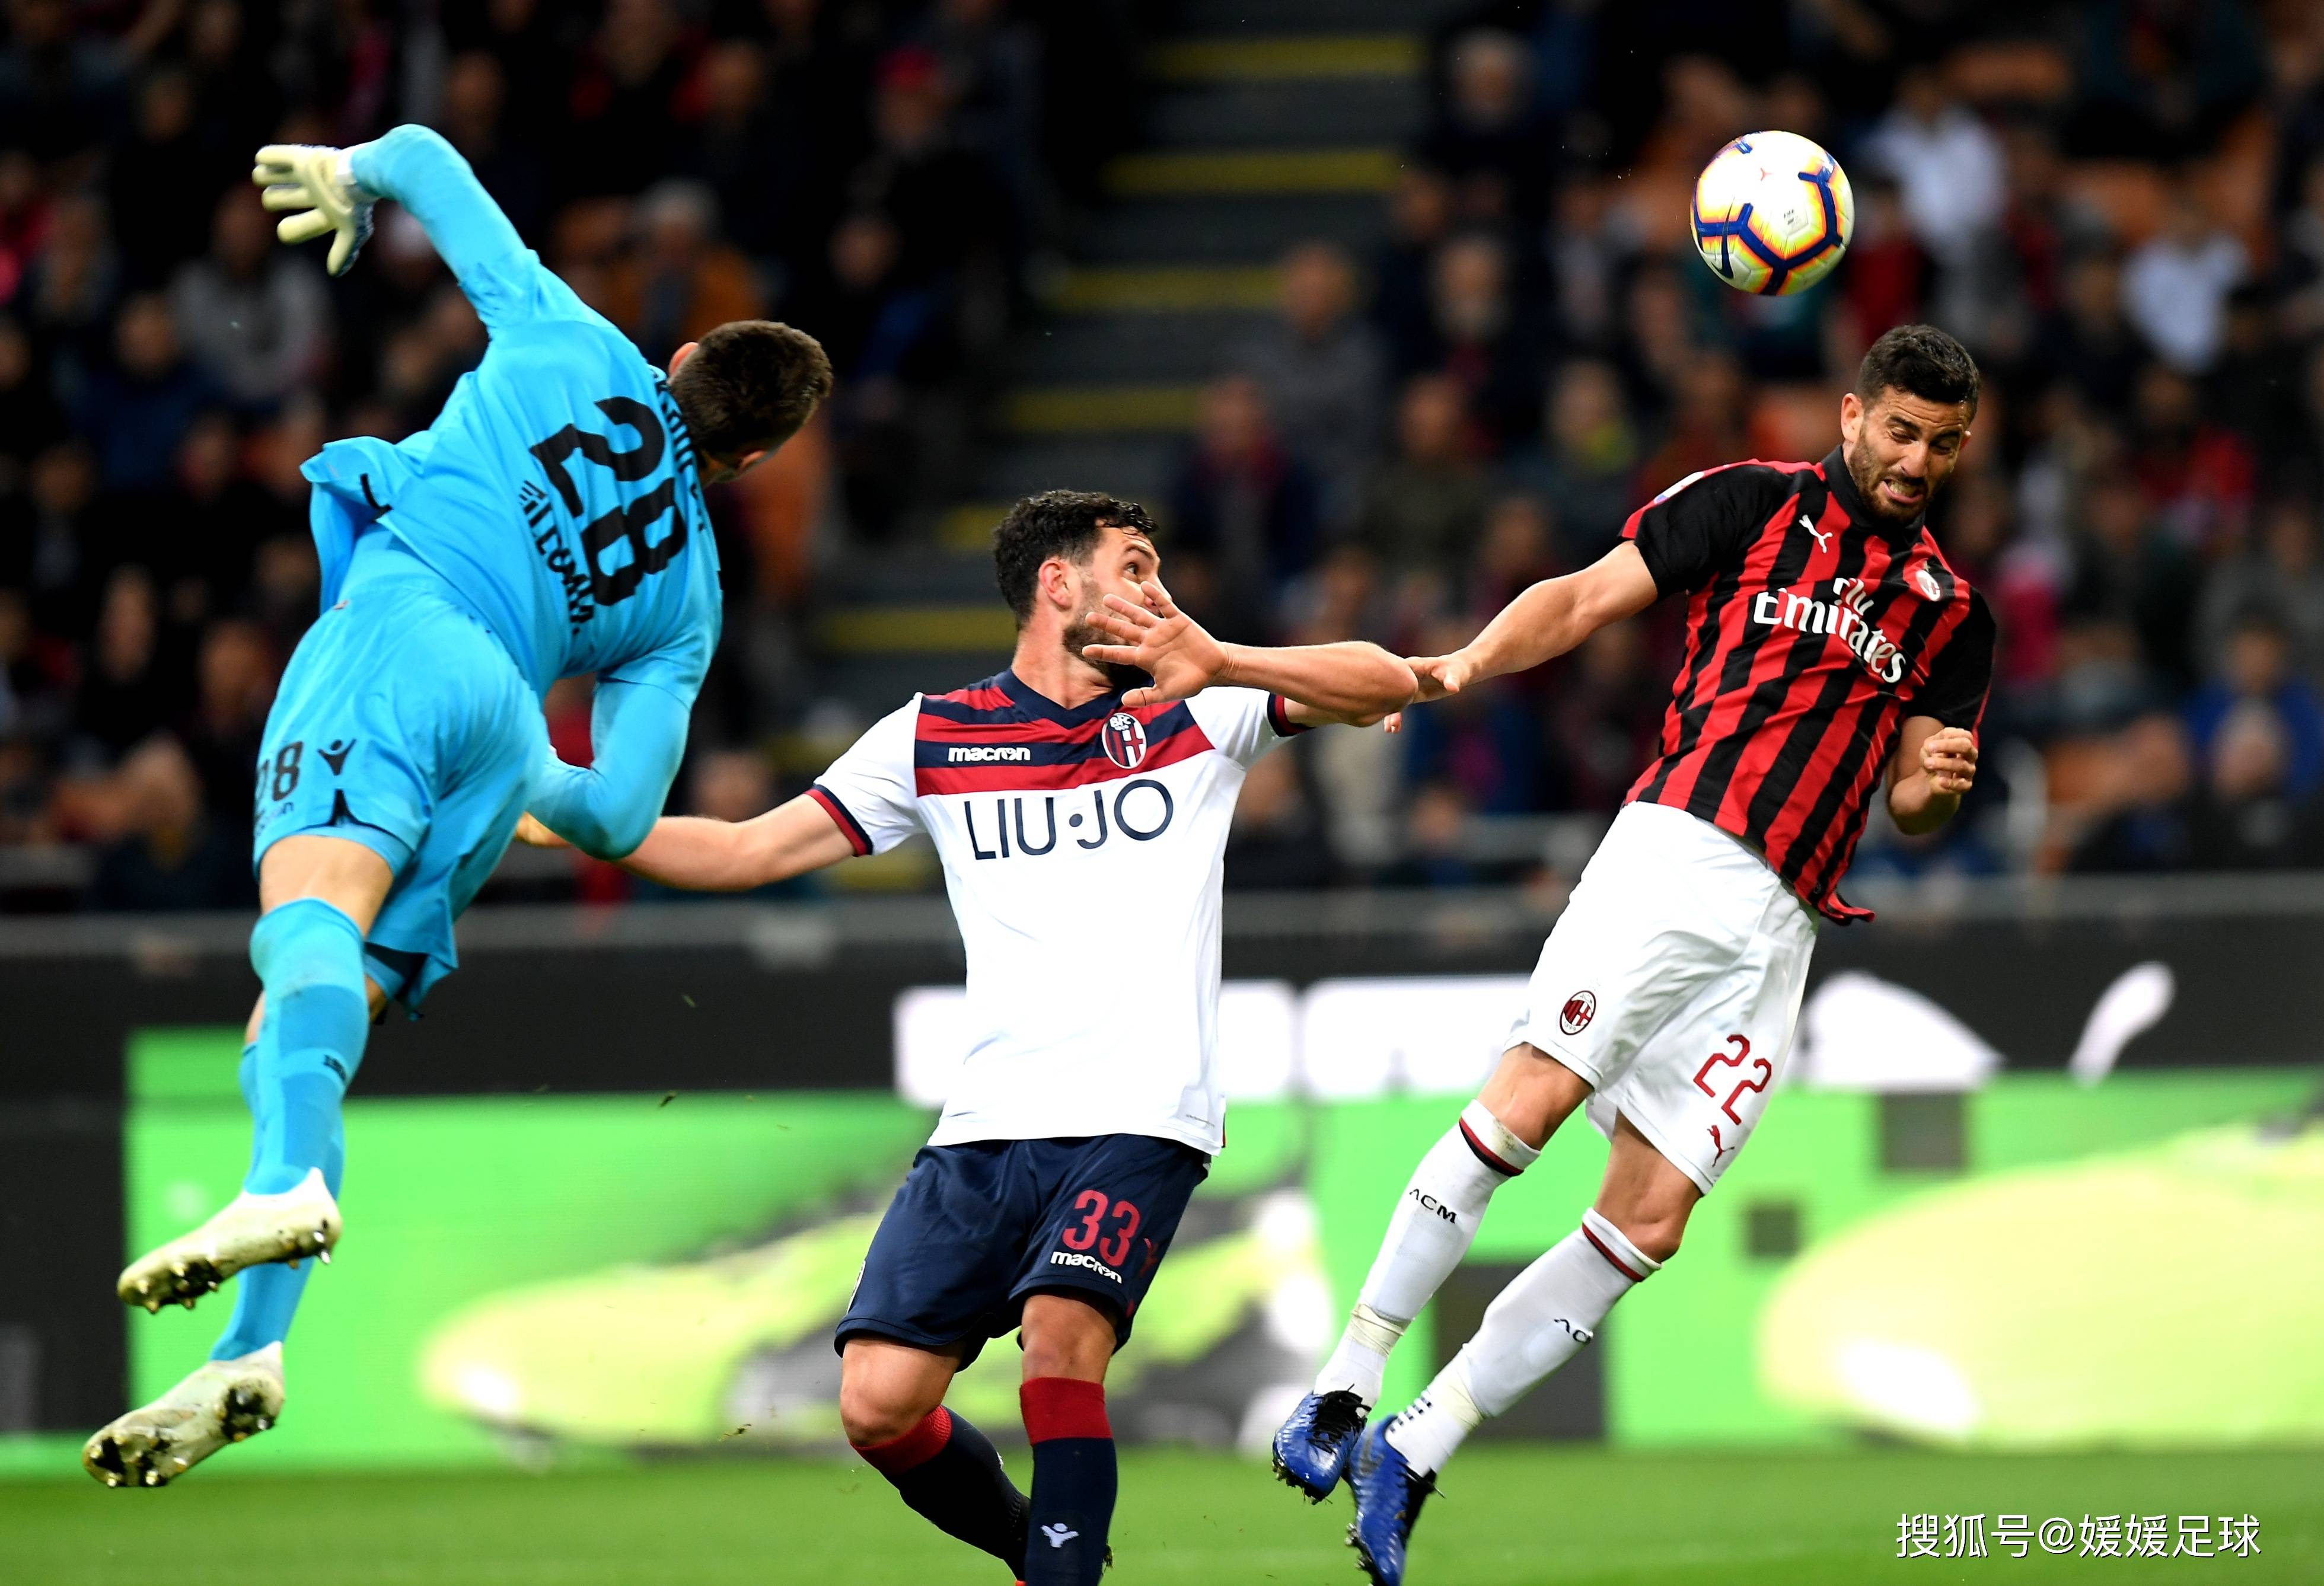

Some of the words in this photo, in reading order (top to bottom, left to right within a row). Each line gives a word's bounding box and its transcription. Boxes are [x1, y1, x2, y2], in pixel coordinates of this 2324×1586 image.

[530, 395, 688, 606] 28
[1834, 577, 1874, 616] Fly
[1753, 588, 1907, 684] Emirates
[948, 746, 1031, 762] macron
[1693, 1034, 1772, 1125] 22
[1409, 1188, 1456, 1224] ACM
[1062, 1189, 1141, 1266] 33
[1050, 1251, 1123, 1284] macron
[1554, 1318, 1592, 1344] AC
